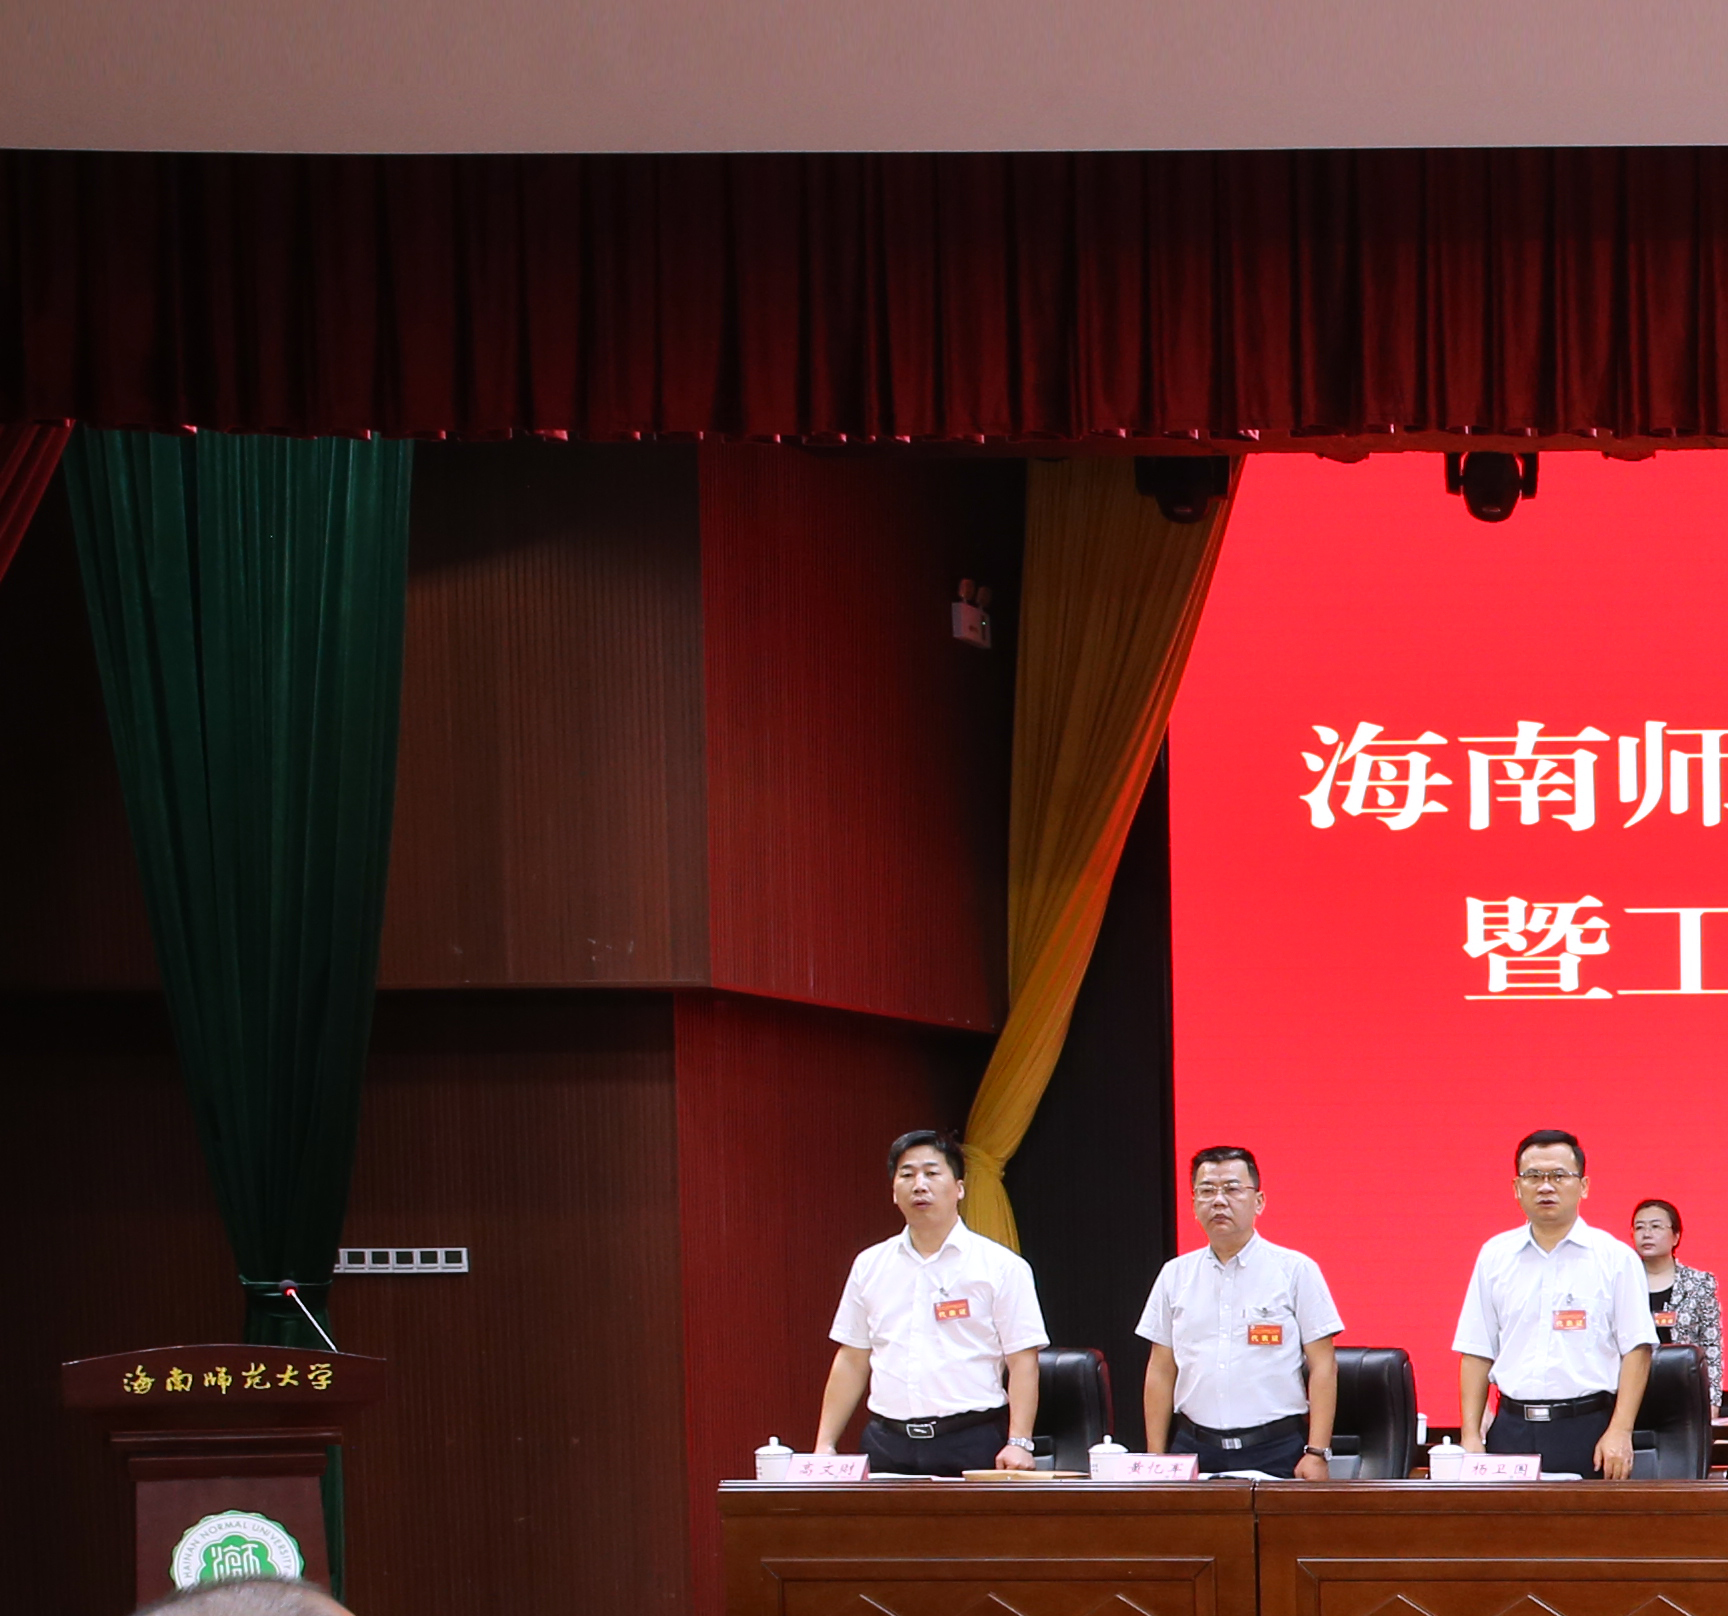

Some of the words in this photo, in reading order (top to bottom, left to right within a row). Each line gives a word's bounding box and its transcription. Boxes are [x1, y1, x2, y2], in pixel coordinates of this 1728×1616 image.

[123, 1363, 333, 1395] 海南师范大学
[183, 1540, 200, 1579] HAINAN
[201, 1520, 248, 1540] NORMAL
[251, 1523, 293, 1571] UNIVERSITY
